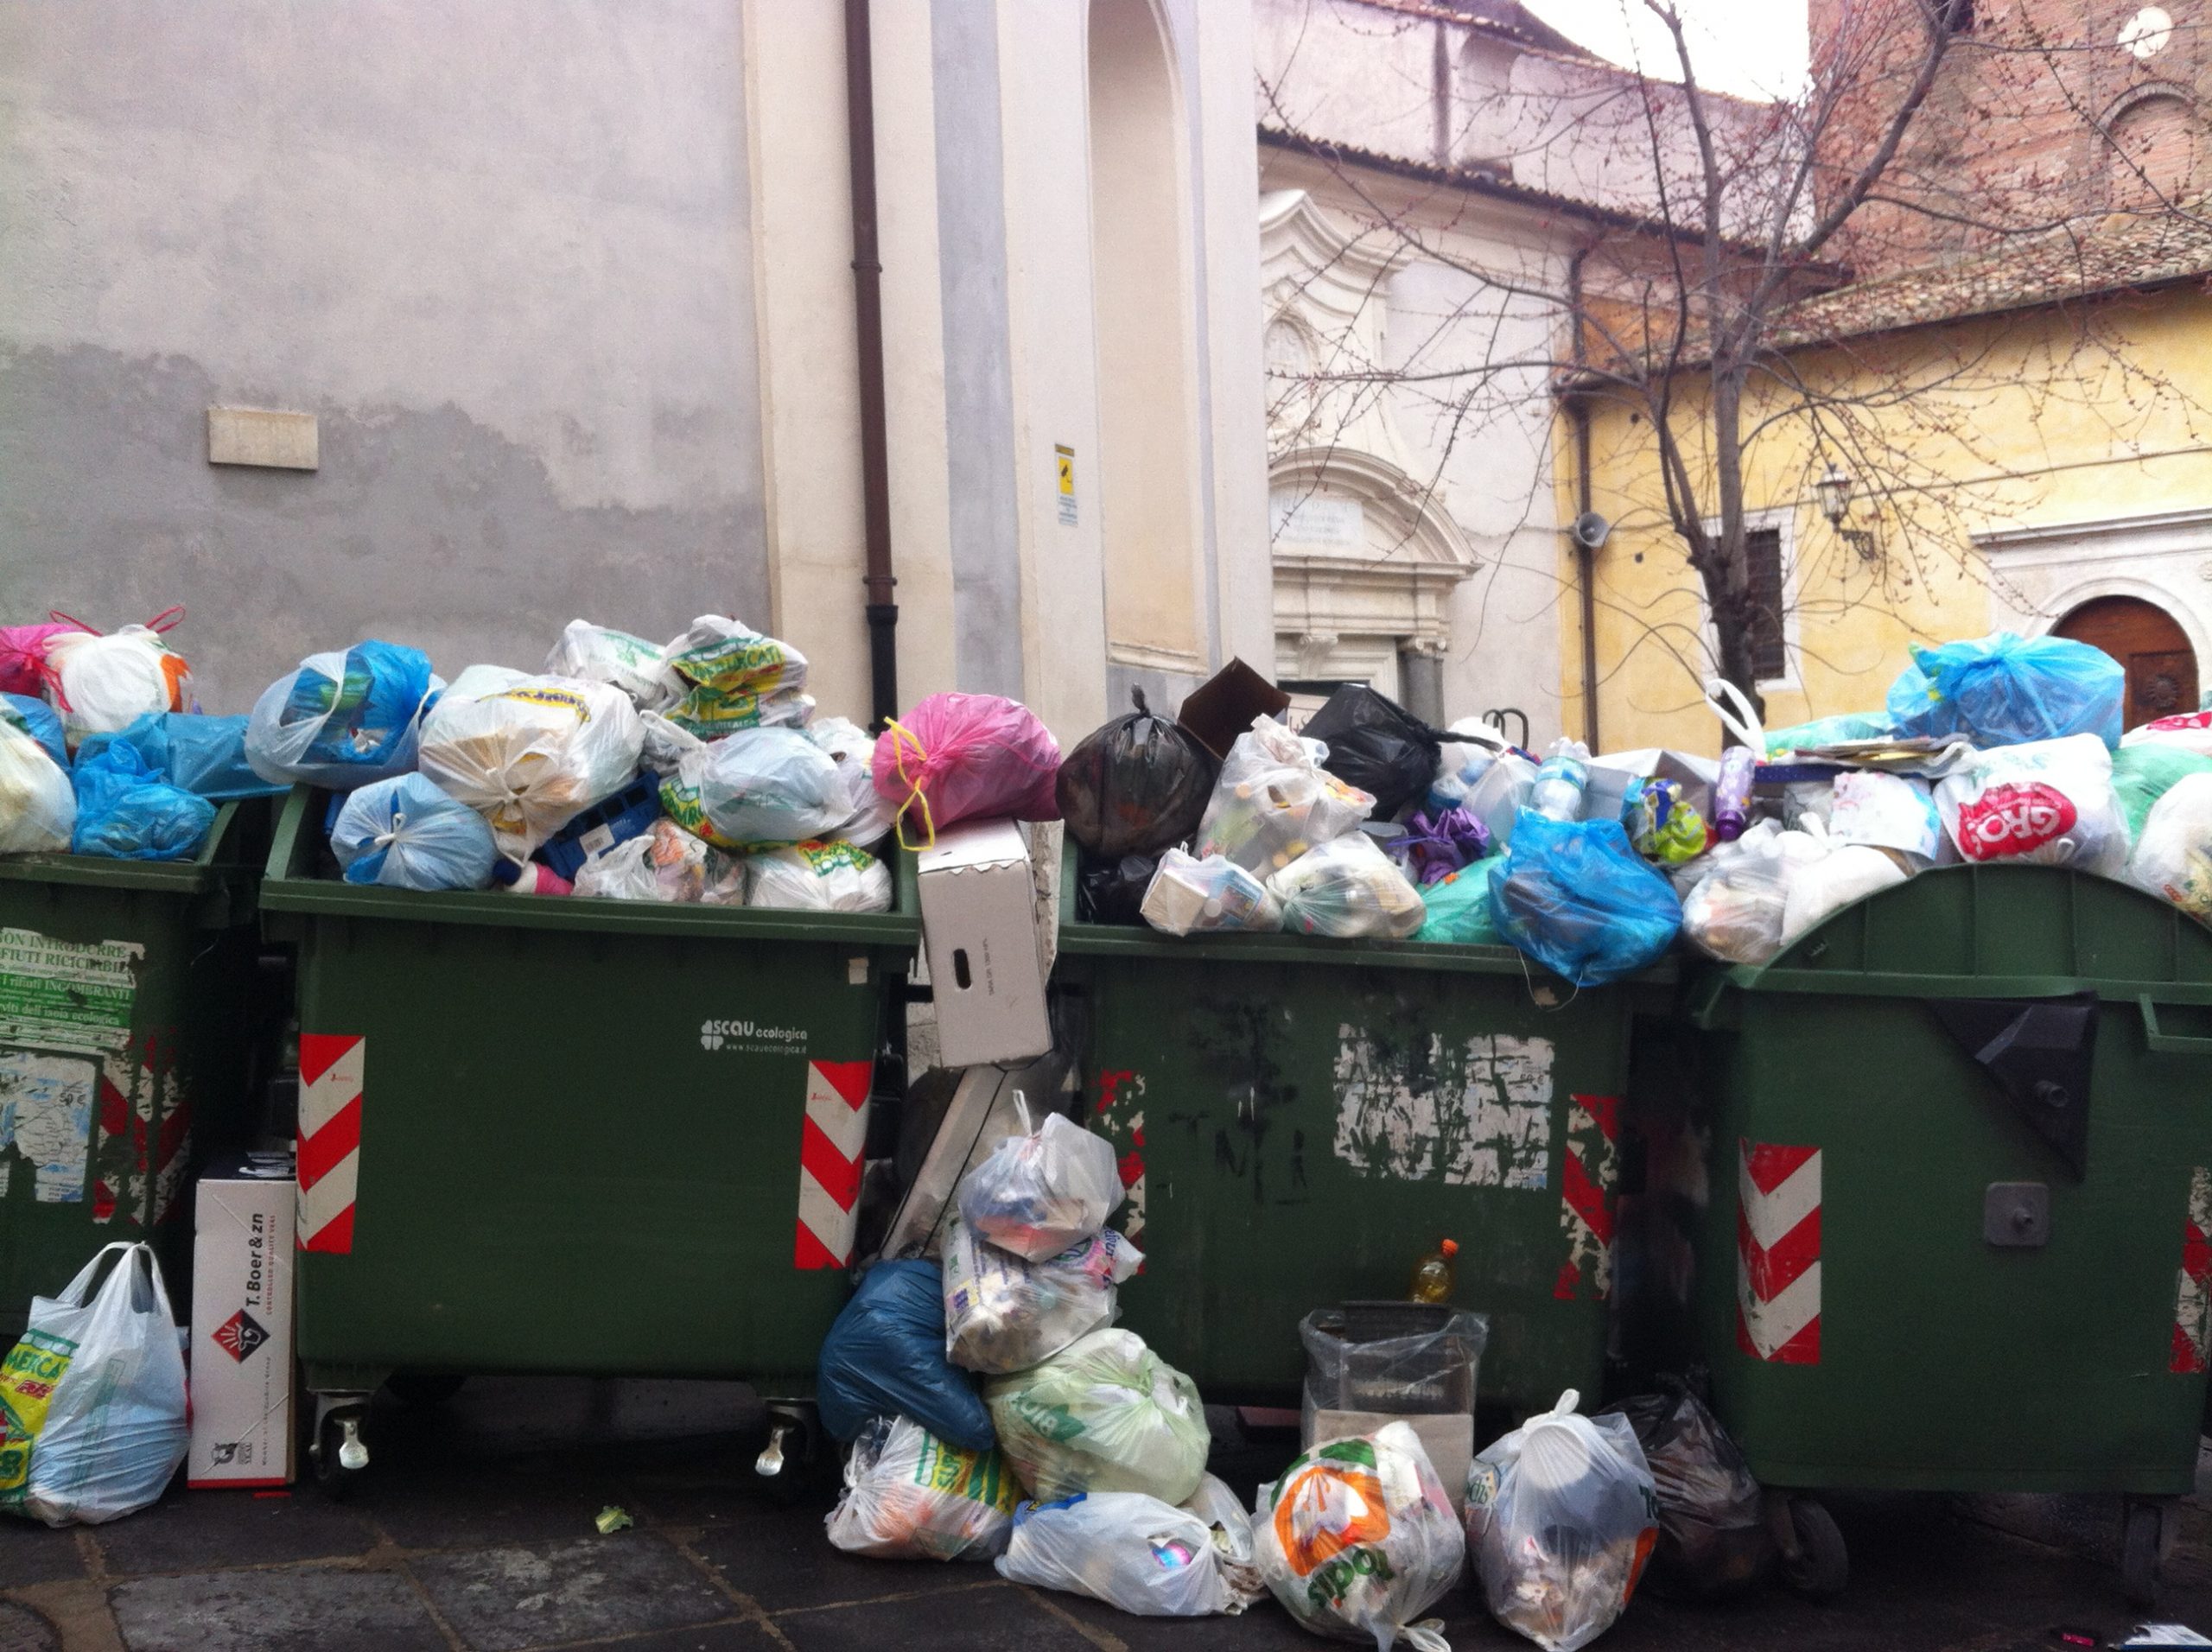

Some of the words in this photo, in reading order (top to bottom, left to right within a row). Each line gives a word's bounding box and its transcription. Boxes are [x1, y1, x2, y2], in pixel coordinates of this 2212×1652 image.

[755, 1026, 808, 1043] ecologica
[252, 1213, 264, 1234] zn
[248, 1236, 263, 1249] &
[247, 1250, 263, 1292] Boer
[246, 1295, 261, 1307] T.
